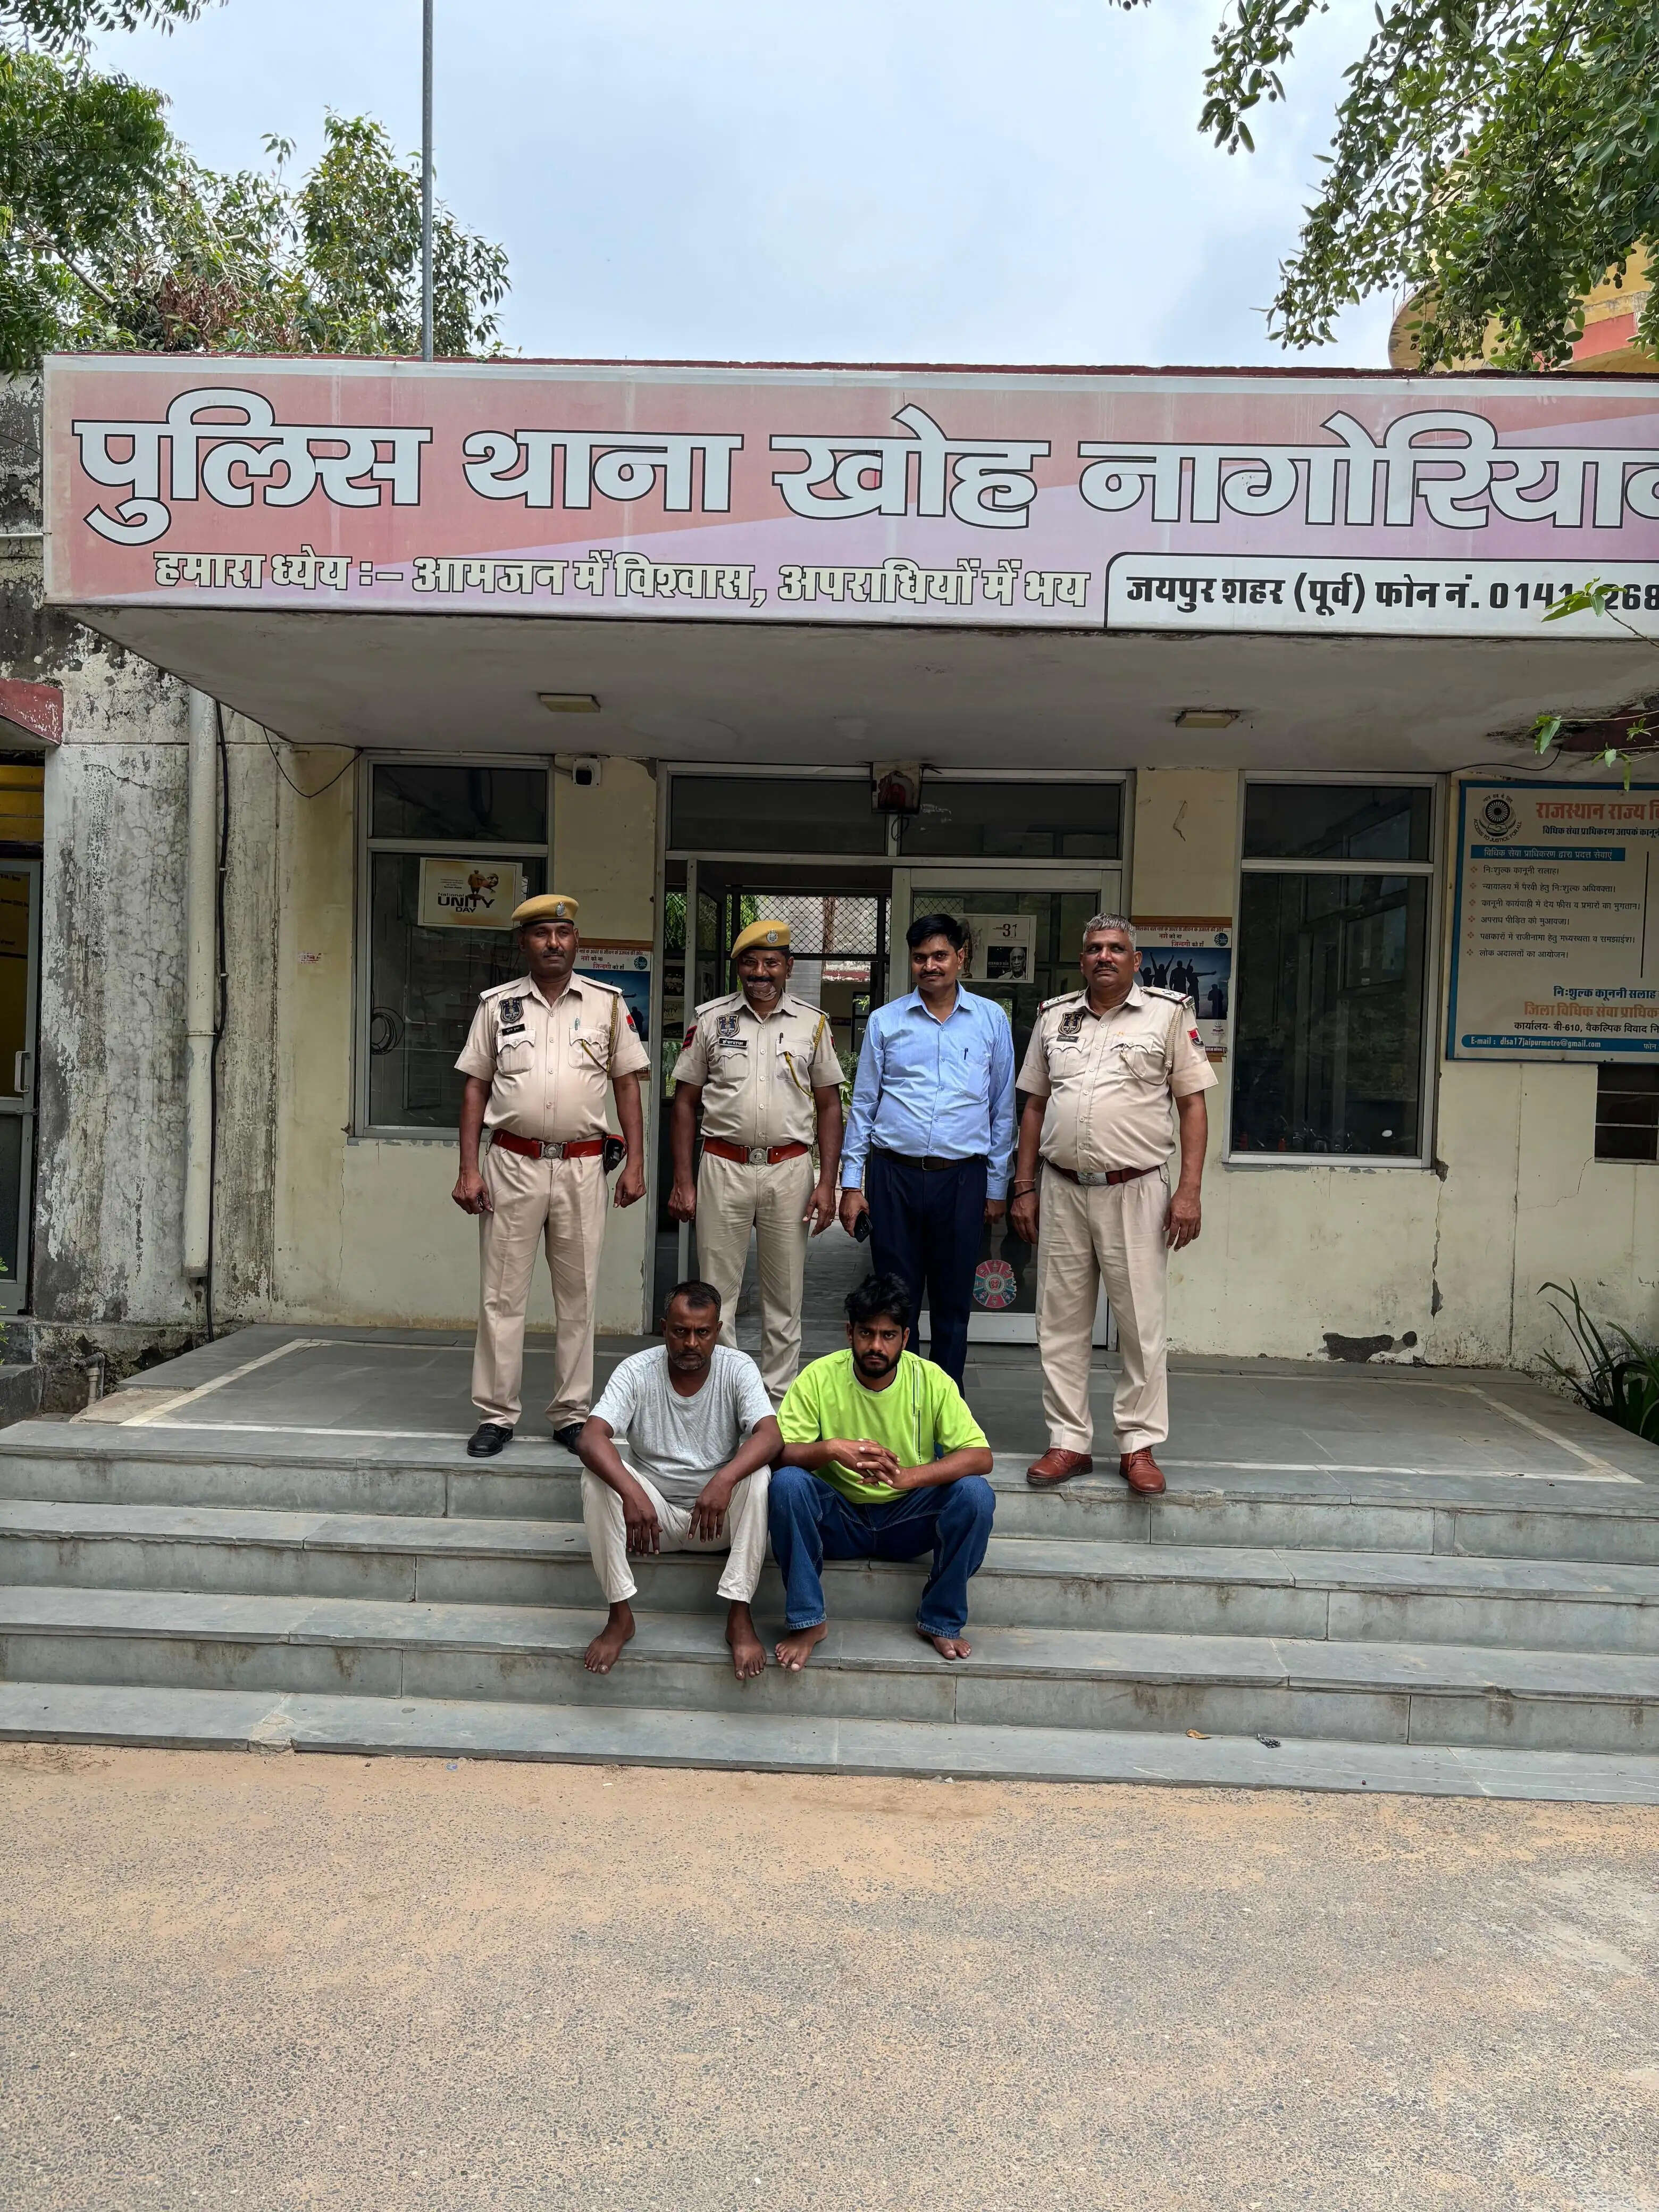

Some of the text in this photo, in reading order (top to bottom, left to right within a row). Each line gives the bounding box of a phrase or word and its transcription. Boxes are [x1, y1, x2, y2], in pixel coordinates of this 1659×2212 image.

[72, 387, 433, 546] पुलिस
[463, 429, 744, 512] थाना
[769, 404, 1052, 529] खोह
[153, 551, 267, 588] हमारा
[271, 544, 353, 590] ध्येय
[412, 556, 569, 594] आमजन
[573, 549, 613, 596] में
[613, 551, 768, 608] विश्वास,
[777, 557, 981, 605] अपराधियों
[981, 559, 1023, 606] में
[1024, 571, 1091, 607] भय
[1126, 577, 1217, 613] जयपुर
[1222, 579, 1286, 605] शहर
[1294, 572, 1365, 617] (पूर्व)
[1375, 574, 1440, 608] फोन
[1445, 574, 1479, 608] नं.
[1536, 802, 1605, 819] राजस्थान
[1608, 804, 1647, 820] राज्य
[1473, 818, 1484, 836] ACCESS
[1509, 829, 1519, 839] FOR
[1543, 825, 1565, 834] विधिक
[1581, 826, 1615, 835] प्राधिकरण
[1616, 827, 1639, 836] आपके
[1484, 847, 1506, 857] विधिक
[1508, 847, 1521, 857] सेवा
[1524, 848, 1556, 858] प्राधिकरण
[1558, 850, 1573, 859] द्वारा
[1513, 865, 1535, 876] कानूनी
[1522, 882, 1537, 891] पैरवी
[1540, 882, 1549, 893] हेतु
[438, 895, 496, 908] UNITY
[1481, 898, 1503, 909] कानूनी
[1505, 898, 1532, 908] कार्यवाही
[1543, 899, 1554, 908] देय
[1556, 899, 1571, 909] फीस
[1505, 915, 1526, 925] पीड़ित
[1528, 916, 1537, 924] को
[1002, 924, 1017, 937] 31
[1480, 932, 1505, 940] पक्षकारों
[1516, 932, 1545, 941] राजीनामा
[1547, 933, 1557, 944] हेतु
[1479, 948, 1495, 957] लोक
[1497, 948, 1524, 957] अदालतों
[1628, 990, 1656, 999] सलाह
[1524, 1001, 1659, 1018] जिला विधिक सेवा प्राधिक
[1585, 1021, 1622, 1033] वैकल्पिक
[1624, 1023, 1648, 1034] विवाद
[1470, 1036, 1492, 1045] E-mail
[1500, 1037, 1601, 1049] dlsa17jaipurmetro@gmail.com
[1644, 1042, 1657, 1050] फोन
